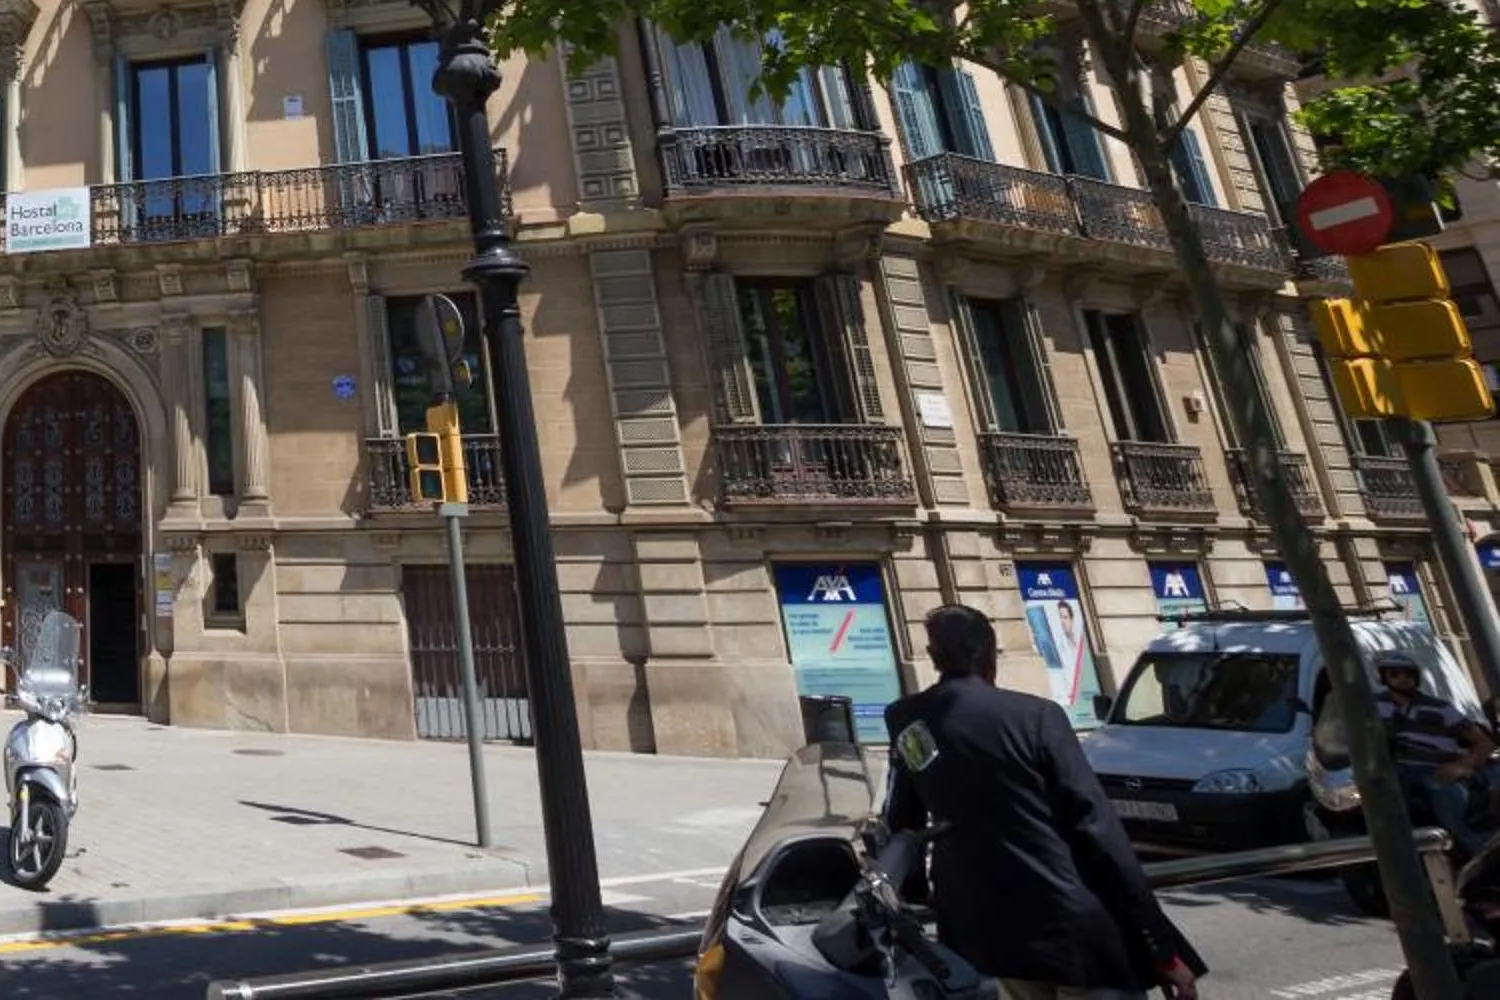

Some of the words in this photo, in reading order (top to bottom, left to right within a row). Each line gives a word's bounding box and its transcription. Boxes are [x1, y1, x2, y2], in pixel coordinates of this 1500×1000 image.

[11, 201, 57, 220] Hostal
[11, 219, 83, 237] Barcelona
[807, 575, 857, 601] AXA
